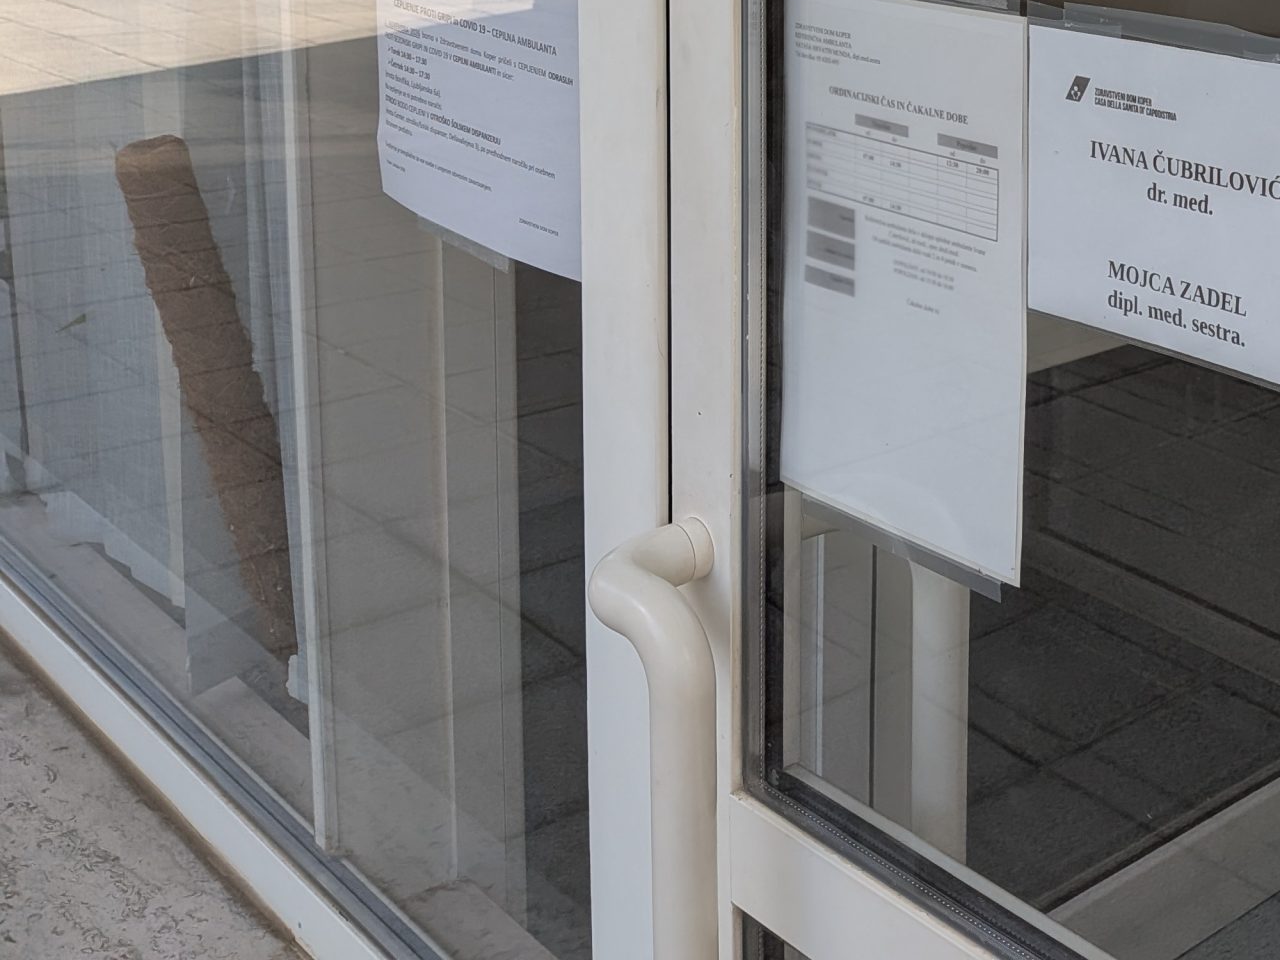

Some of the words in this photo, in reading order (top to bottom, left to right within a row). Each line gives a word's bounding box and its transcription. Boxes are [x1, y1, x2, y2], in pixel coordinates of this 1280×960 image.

[1094, 97, 1107, 107] CASA
[1107, 99, 1122, 110] DELLA
[1126, 93, 1137, 104] DOM
[1090, 140, 1148, 169] IVANA
[1146, 183, 1167, 204] dr.
[1172, 193, 1213, 215] med.
[1107, 260, 1176, 296] MOJCA
[1179, 280, 1247, 316] ZADEL
[1107, 289, 1143, 316] dipl.
[1147, 305, 1187, 328] med.
[1191, 319, 1245, 347] sestra.
